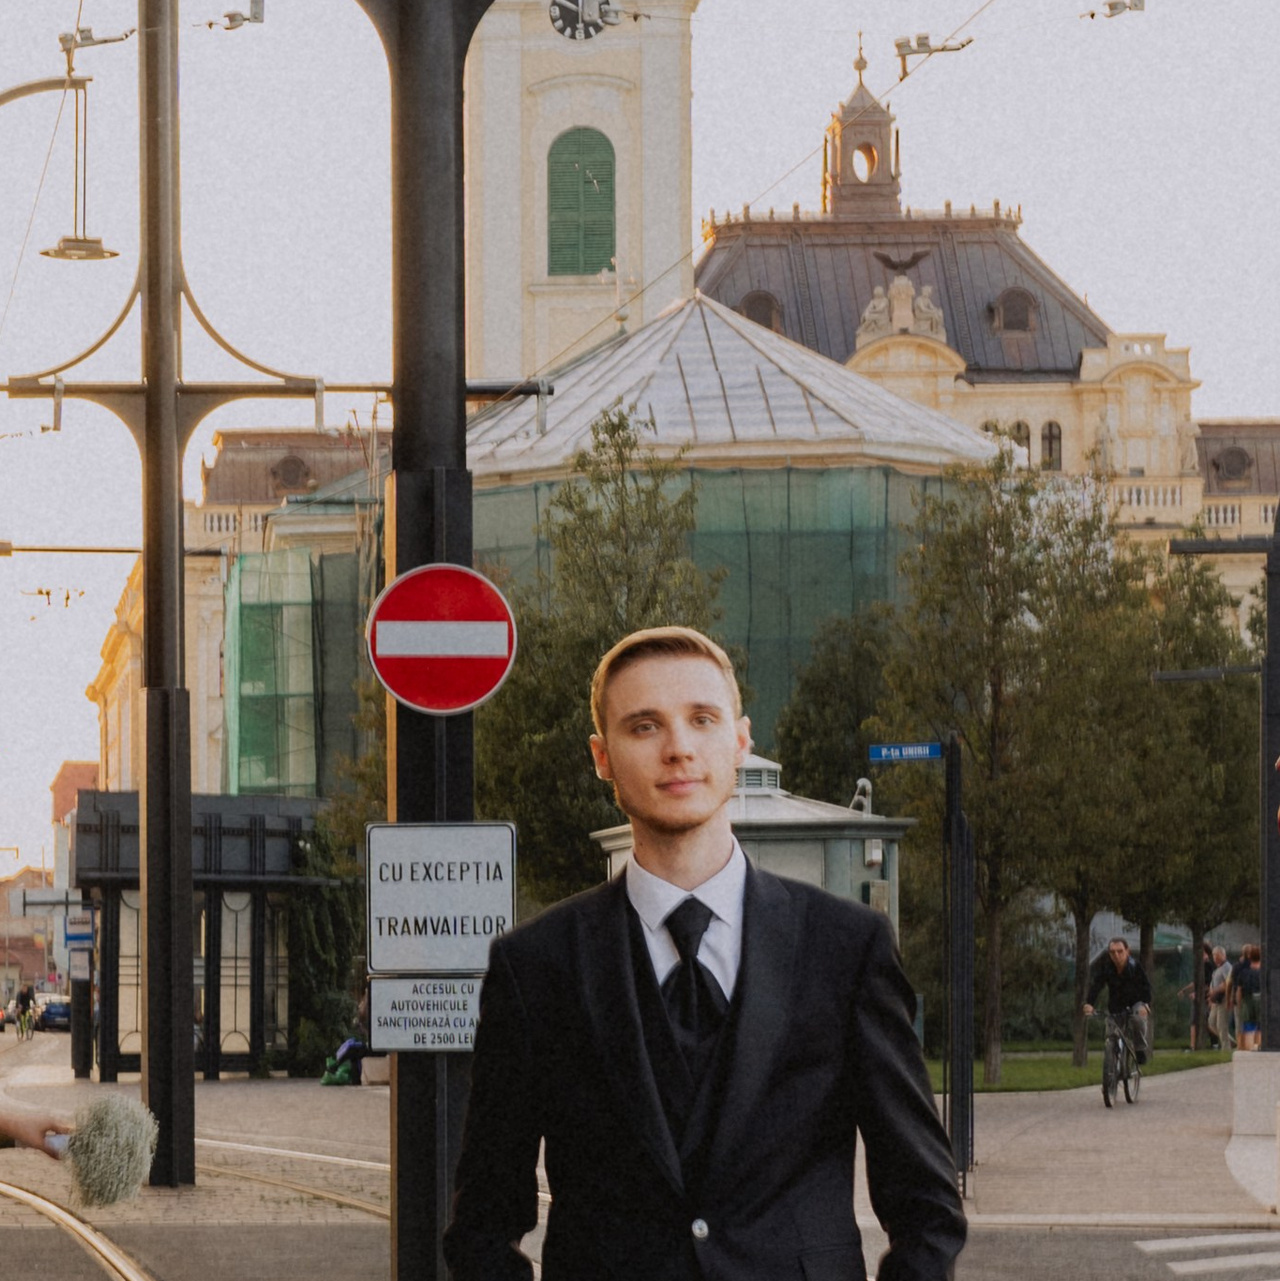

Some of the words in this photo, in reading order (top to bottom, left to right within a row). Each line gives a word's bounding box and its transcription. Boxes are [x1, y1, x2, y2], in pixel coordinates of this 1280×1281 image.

[379, 862, 403, 882] CU
[410, 861, 503, 884] EXCEPȚIA
[375, 915, 507, 937] TRAMVAIELOR
[412, 983, 457, 995] ACCESUL
[460, 983, 475, 995] CU
[390, 1000, 468, 1012] AUTOVEHICULE
[453, 1017, 466, 1028] CU
[413, 1033, 427, 1044] DE
[431, 1033, 455, 1044] 2500
